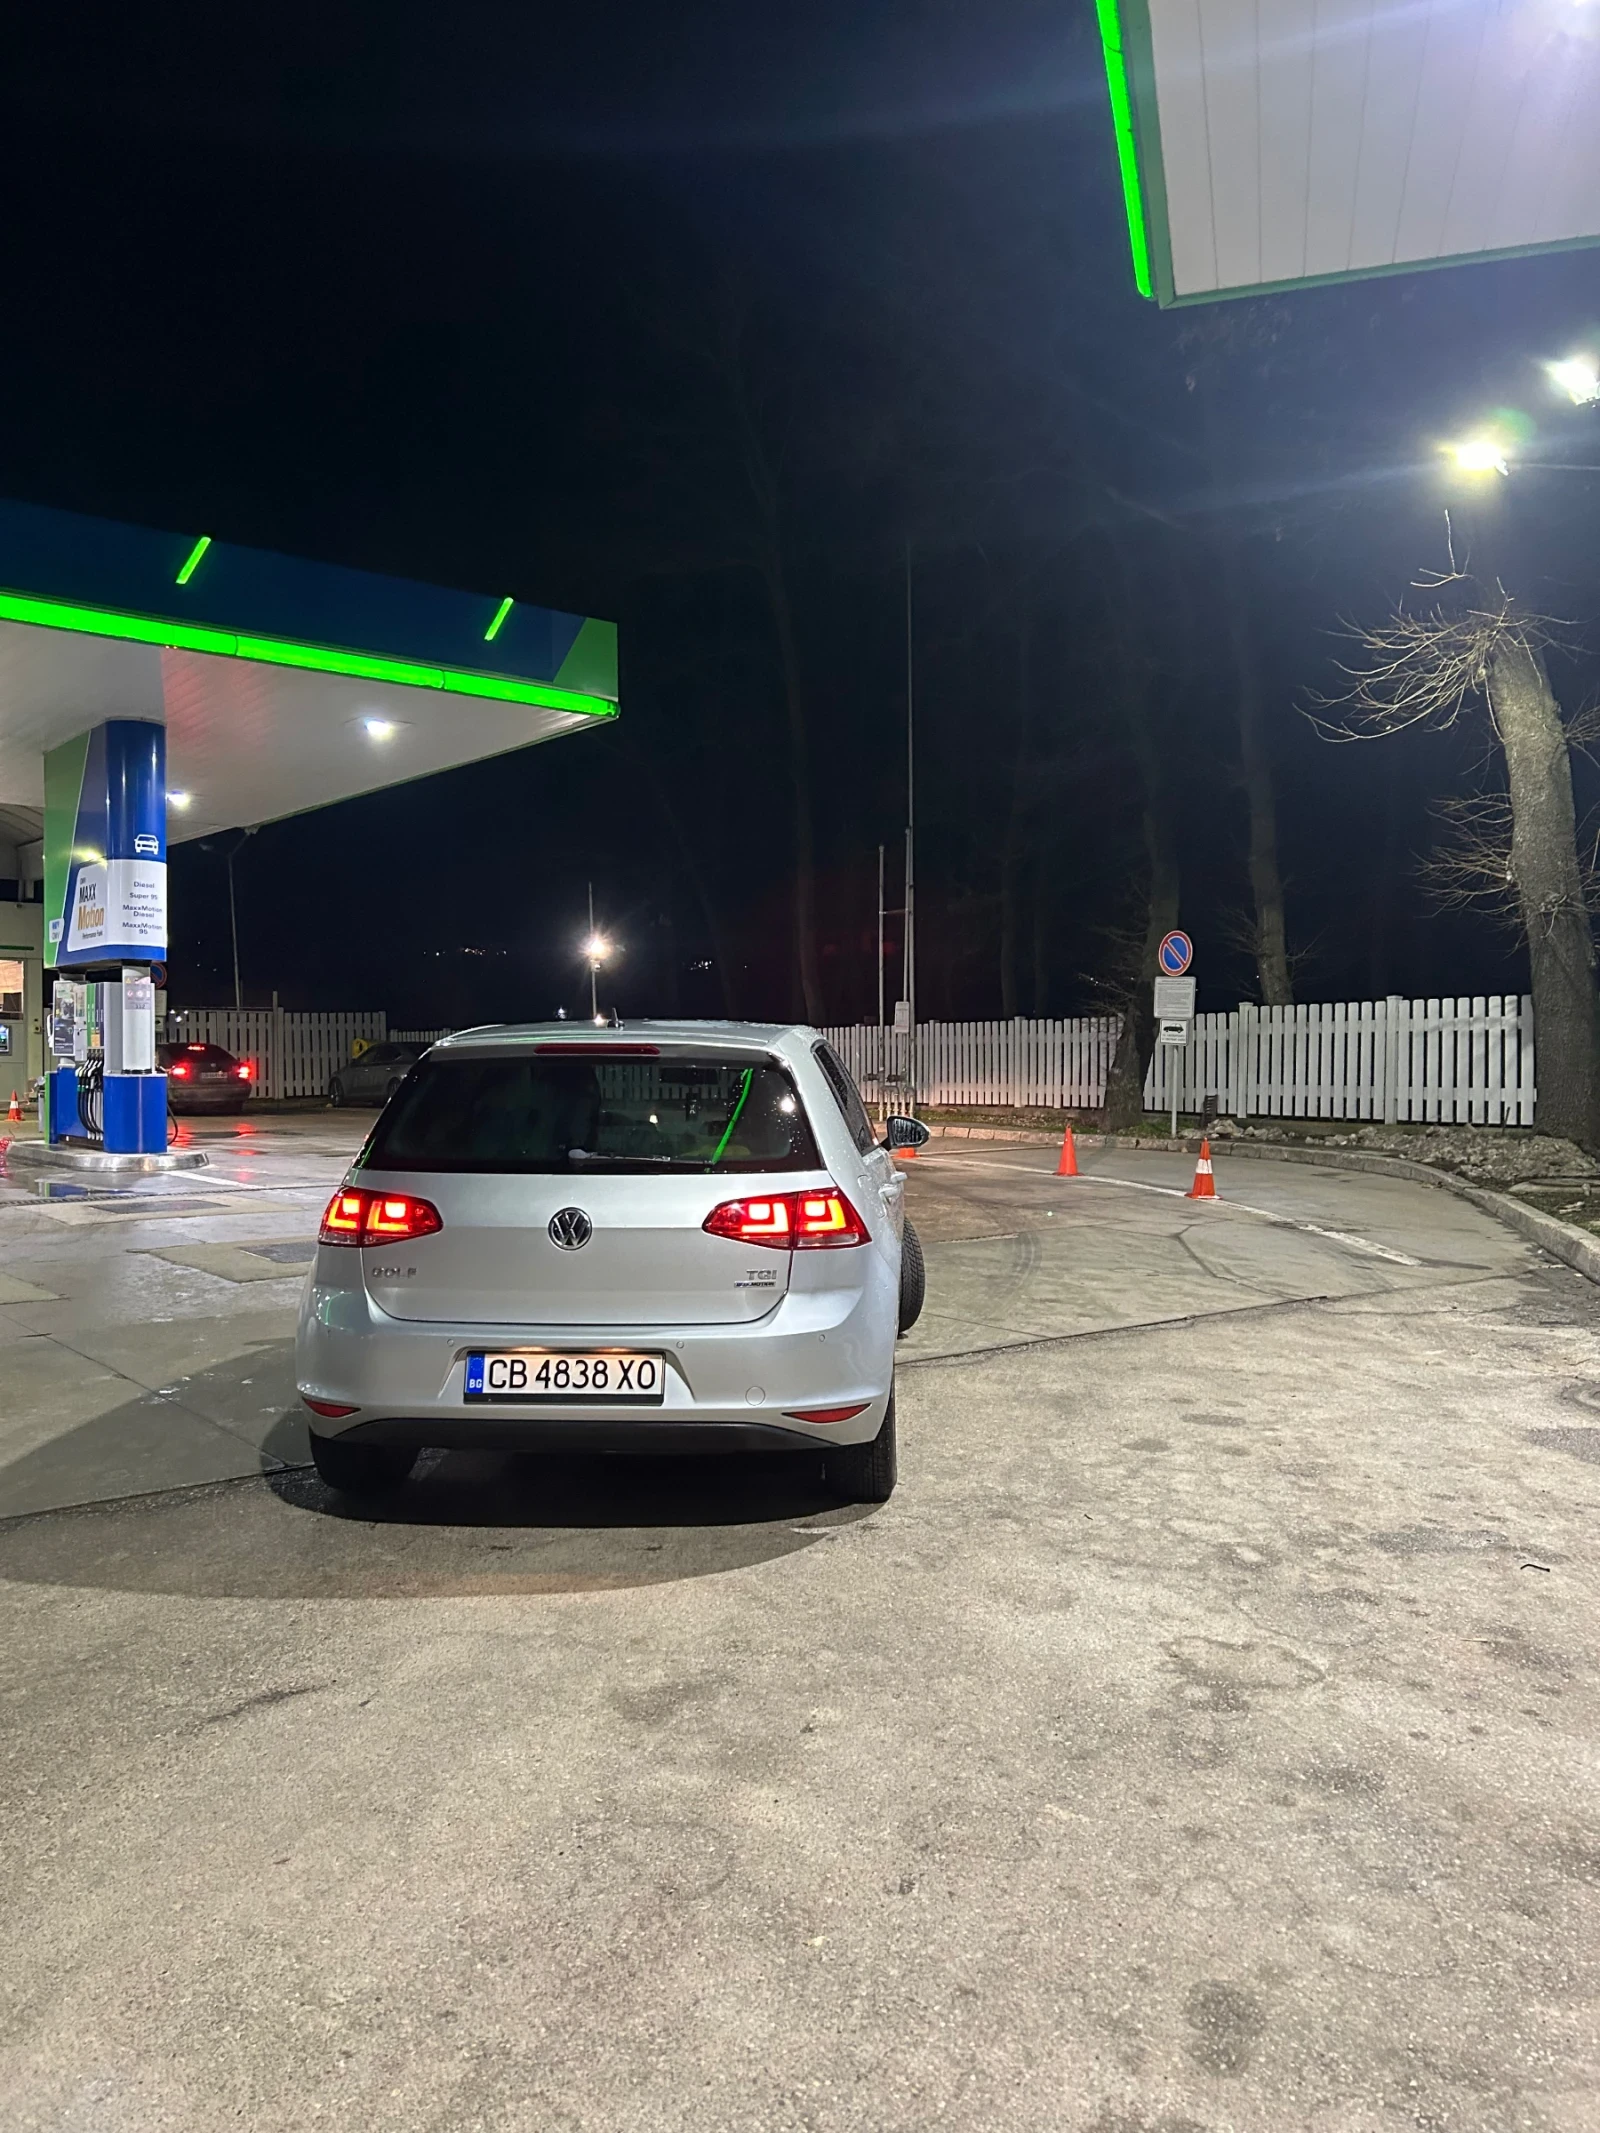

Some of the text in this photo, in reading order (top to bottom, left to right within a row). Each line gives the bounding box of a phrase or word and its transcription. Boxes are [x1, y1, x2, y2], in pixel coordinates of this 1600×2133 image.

[133, 881, 155, 889] Diesel
[79, 883, 97, 904] MAXX
[129, 892, 149, 900] Super
[122, 904, 162, 912] MaxxMotion
[77, 905, 104, 931] Motion
[122, 922, 162, 930] MaxxMotion
[372, 1267, 417, 1279] GOLF
[746, 1269, 777, 1281] TGI
[489, 1359, 656, 1390] CB 4838 XO
[468, 1379, 483, 1389] BG
